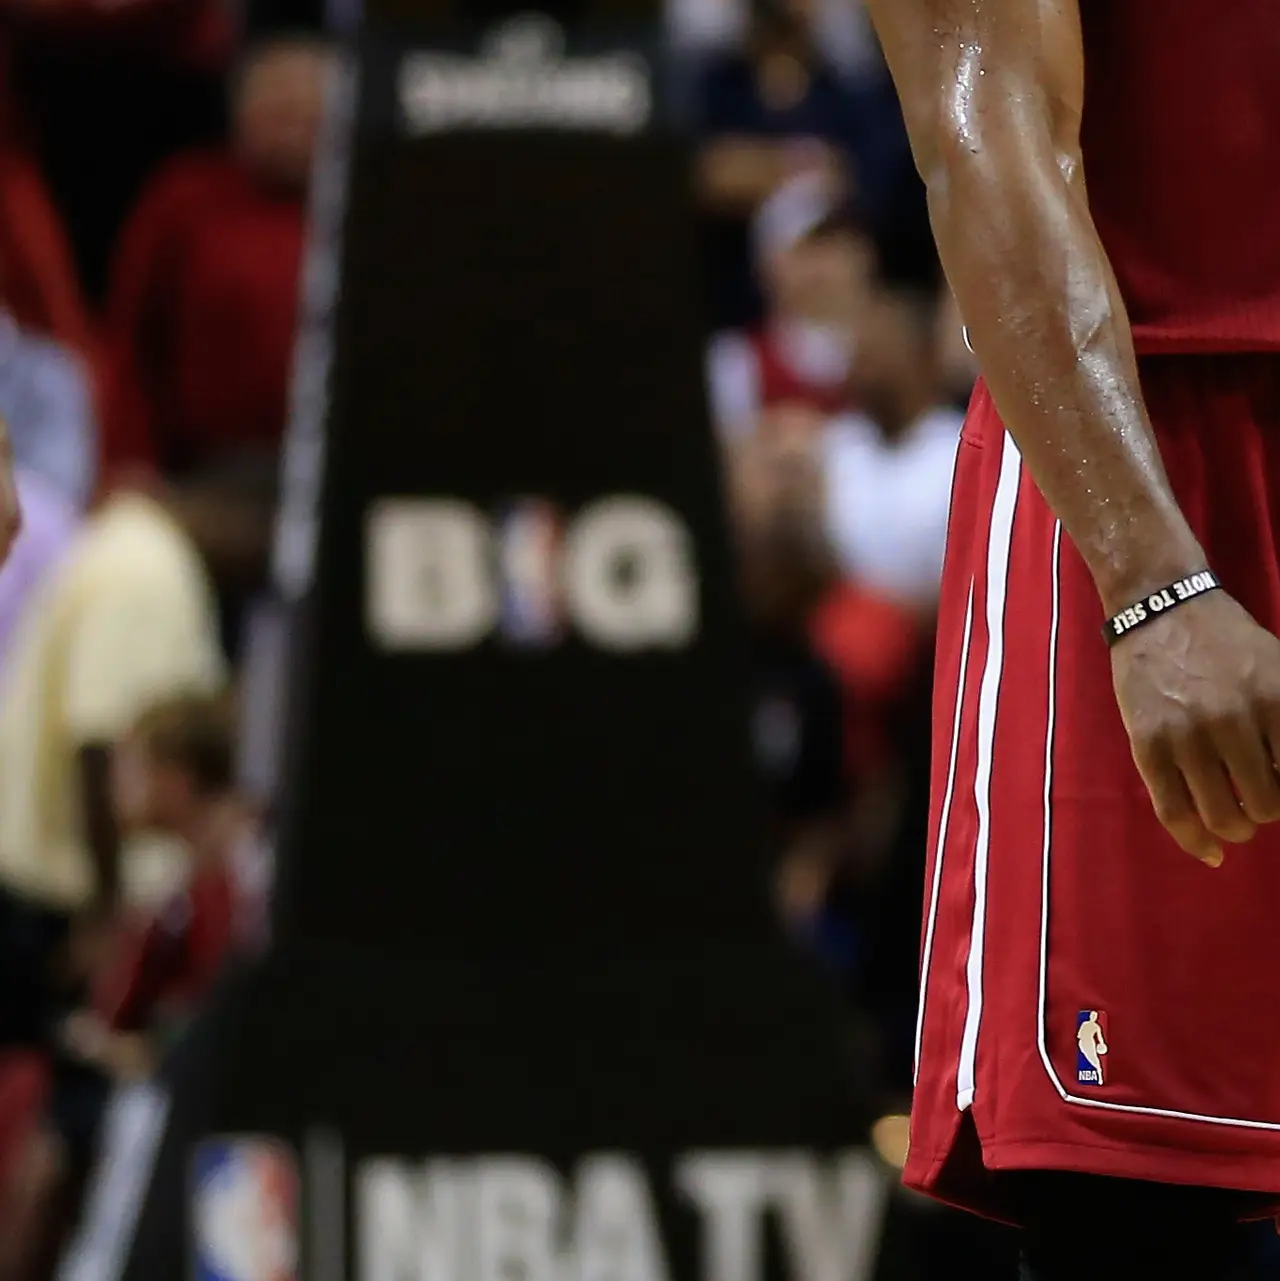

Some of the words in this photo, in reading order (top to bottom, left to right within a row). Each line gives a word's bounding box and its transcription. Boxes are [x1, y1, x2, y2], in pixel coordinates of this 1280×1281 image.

[1172, 571, 1216, 600] NOTE
[1148, 589, 1176, 612] TO
[1112, 602, 1148, 635] SELF
[1078, 1070, 1098, 1081] NBA
[357, 1151, 672, 1281] NBA
[672, 1150, 886, 1281] TV
